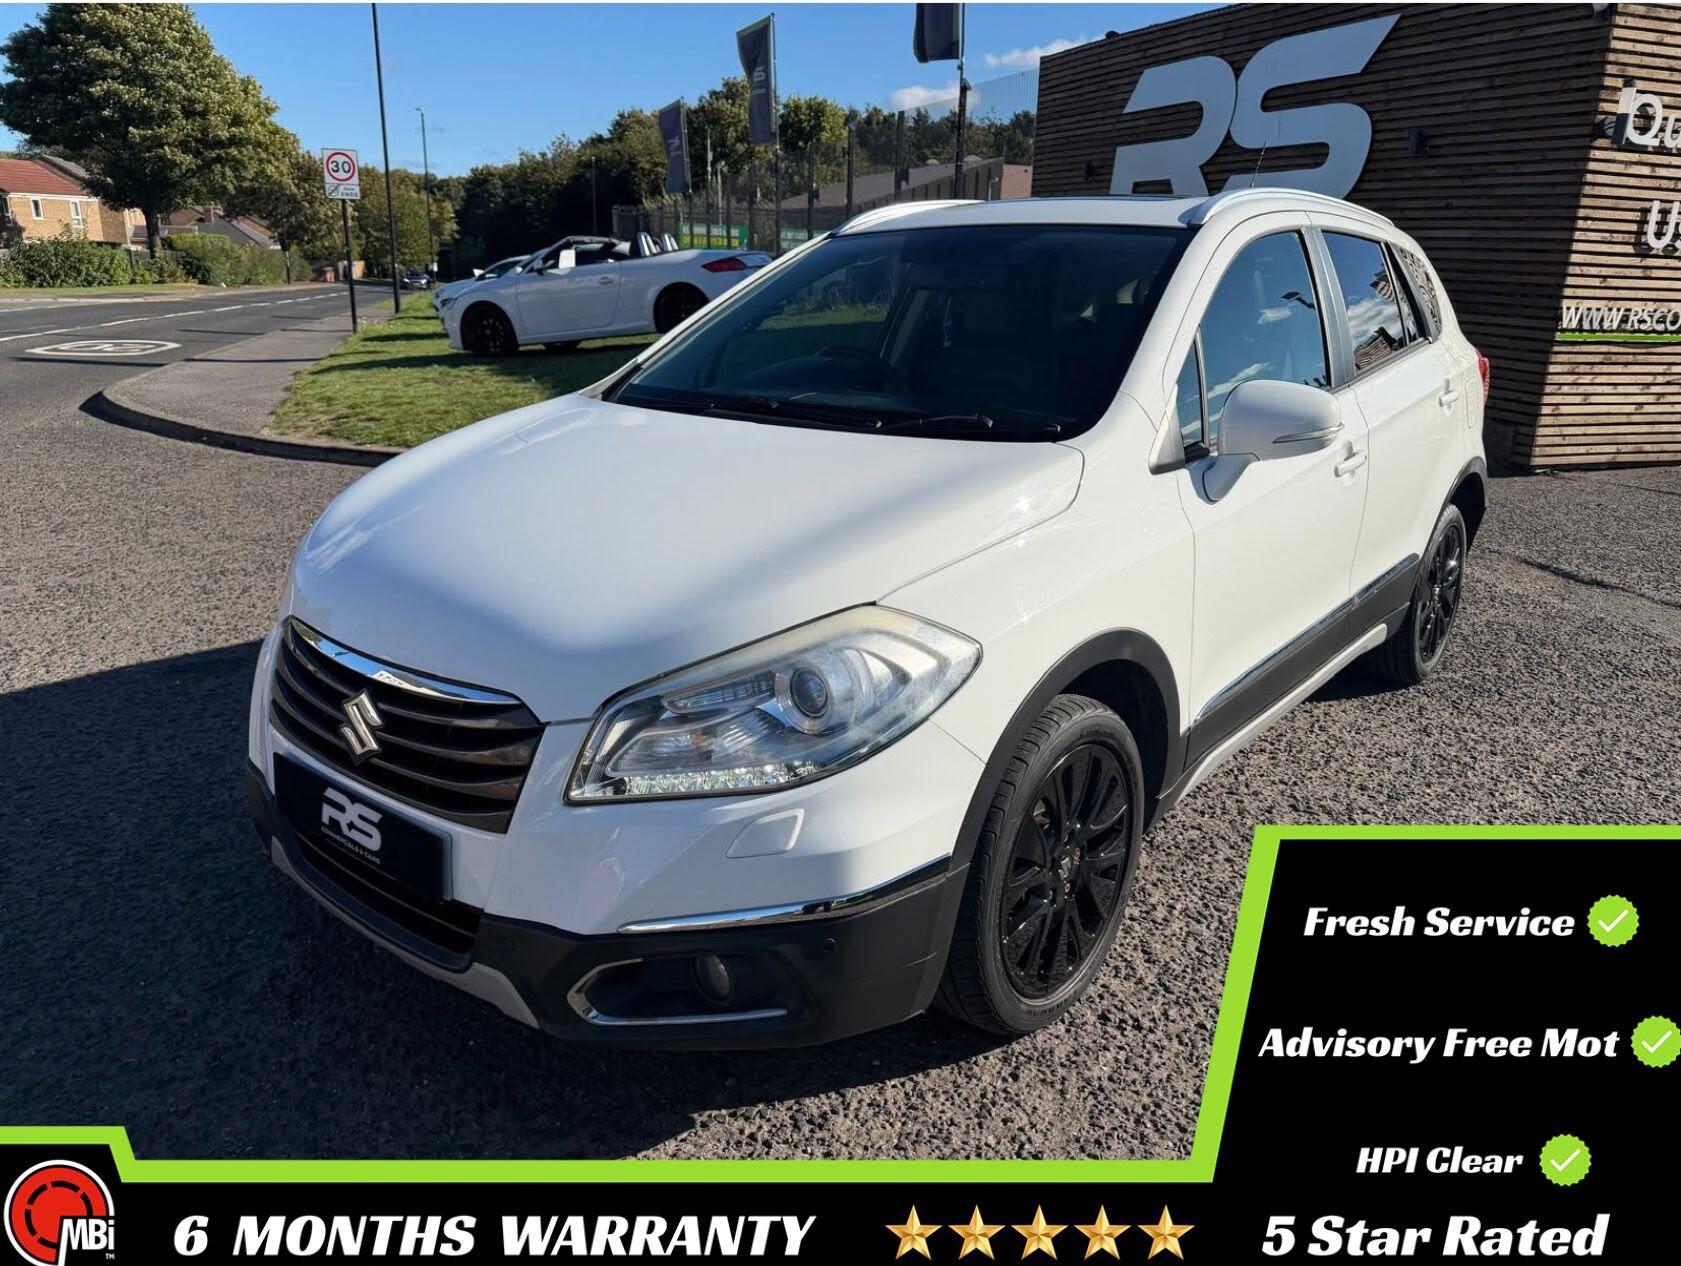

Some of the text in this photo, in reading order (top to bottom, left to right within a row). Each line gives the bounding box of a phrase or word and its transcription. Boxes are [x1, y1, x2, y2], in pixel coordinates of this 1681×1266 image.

[1109, 14, 1402, 200] RS
[331, 160, 351, 173] 30
[1647, 200, 1681, 249] U
[321, 787, 383, 851] RS
